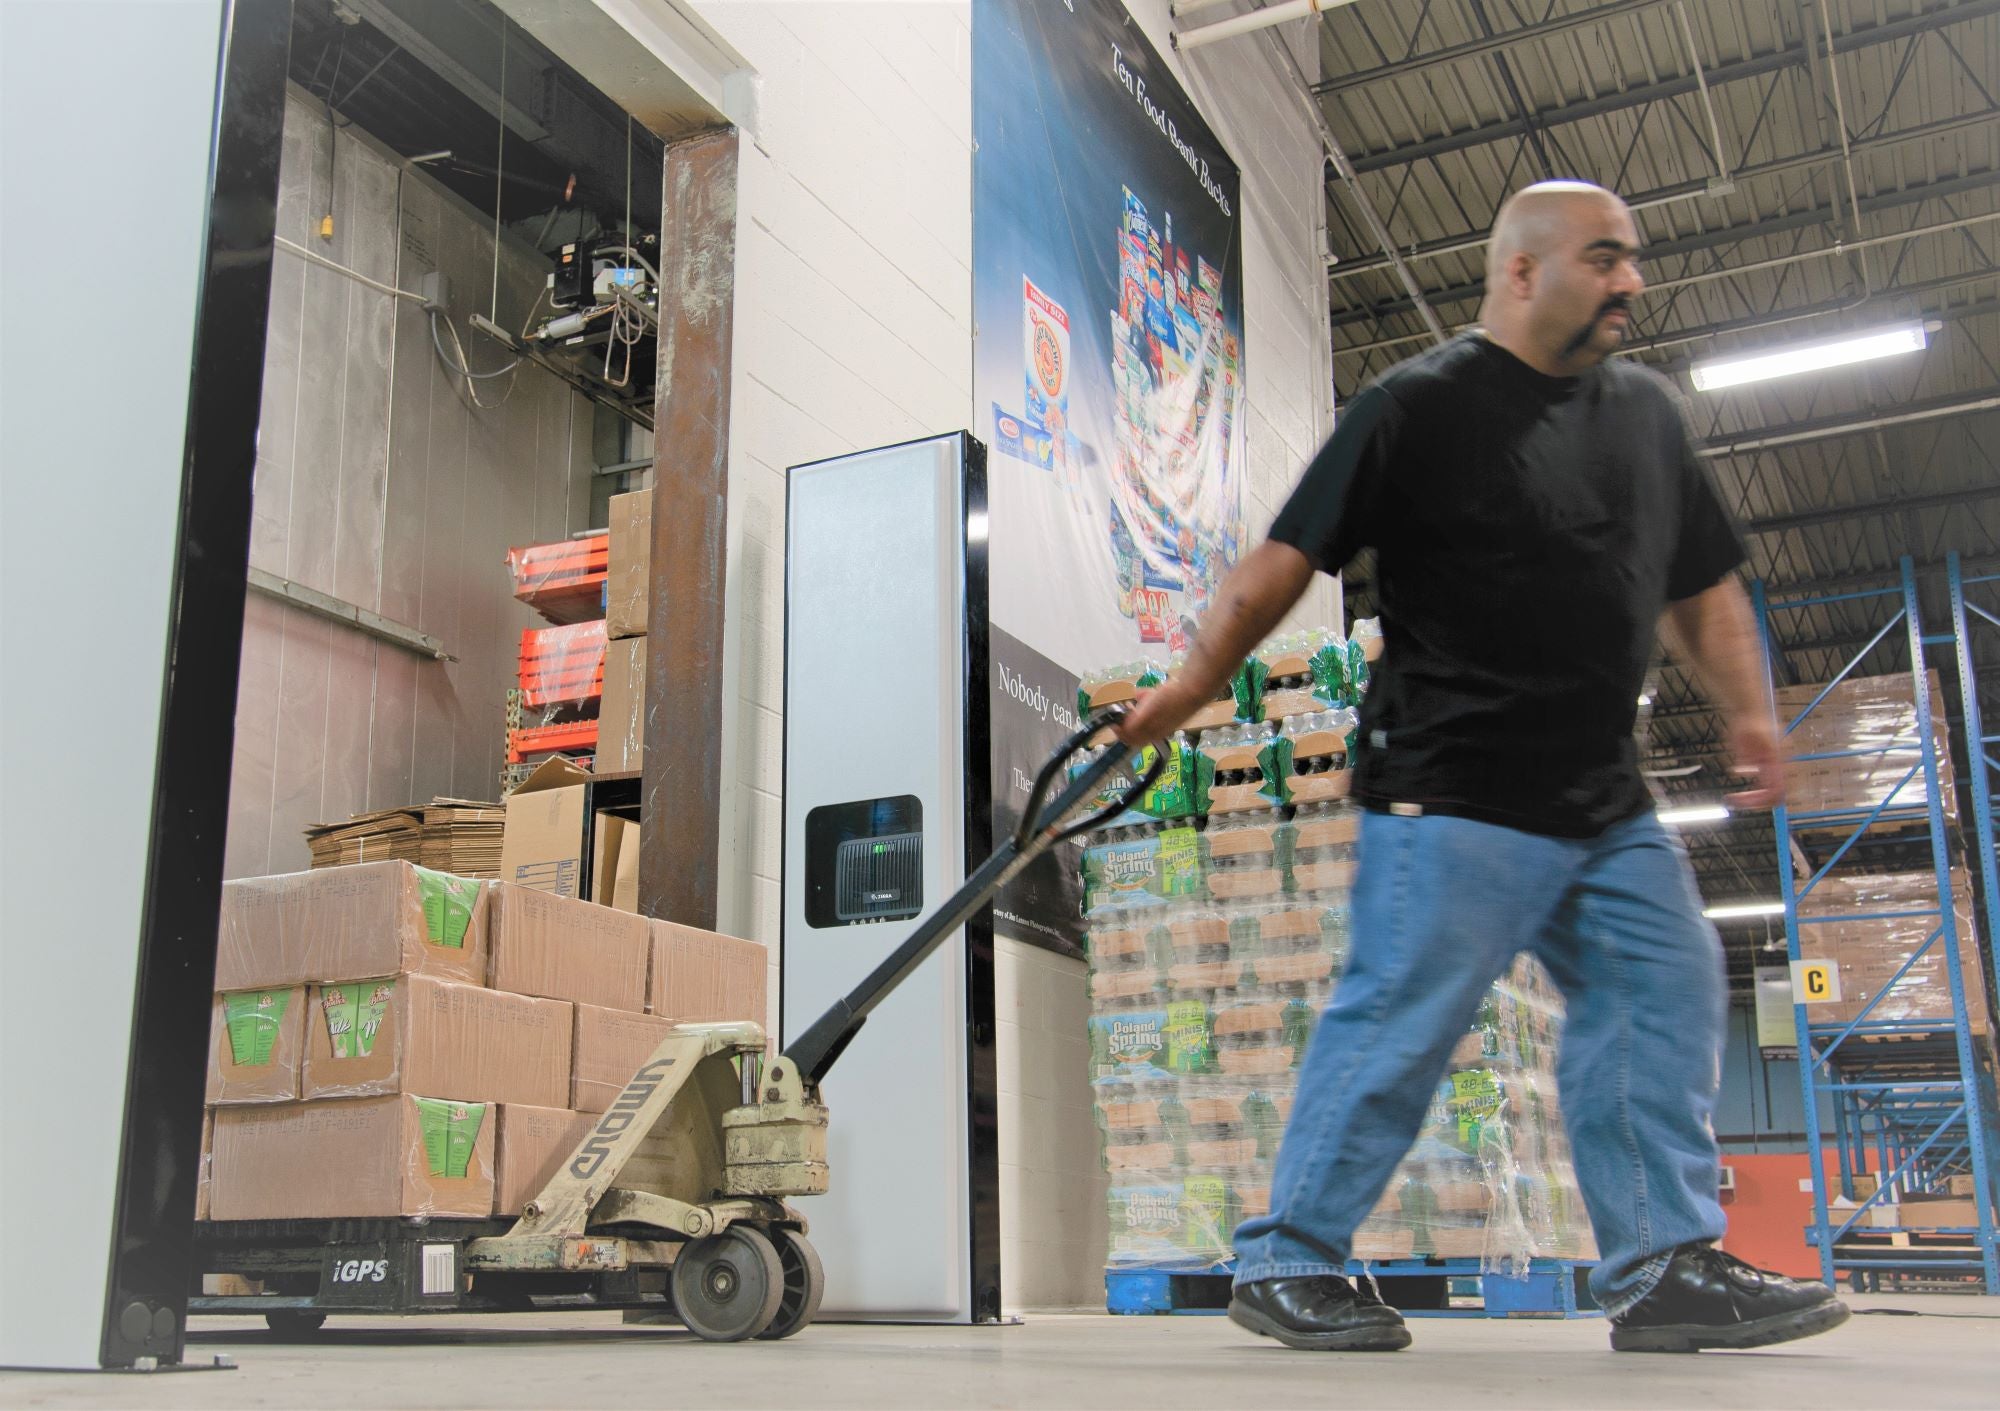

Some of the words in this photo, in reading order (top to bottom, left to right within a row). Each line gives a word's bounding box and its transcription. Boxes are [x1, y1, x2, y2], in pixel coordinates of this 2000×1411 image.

[1111, 42, 1134, 95] Ten
[1137, 75, 1167, 136] Food
[1168, 119, 1198, 175] Bank
[1200, 157, 1231, 217] Bucks
[998, 662, 1051, 721] Nobody
[1052, 702, 1073, 730] can
[1106, 848, 1149, 865] Poland
[1103, 857, 1156, 883] Spring
[1808, 970, 1824, 993] C
[1113, 1020, 1156, 1035] Poland
[1108, 1031, 1163, 1055] Spring
[1130, 1192, 1172, 1208] Poland
[1125, 1205, 1181, 1228] Spring
[332, 1259, 389, 1282] iGPS
